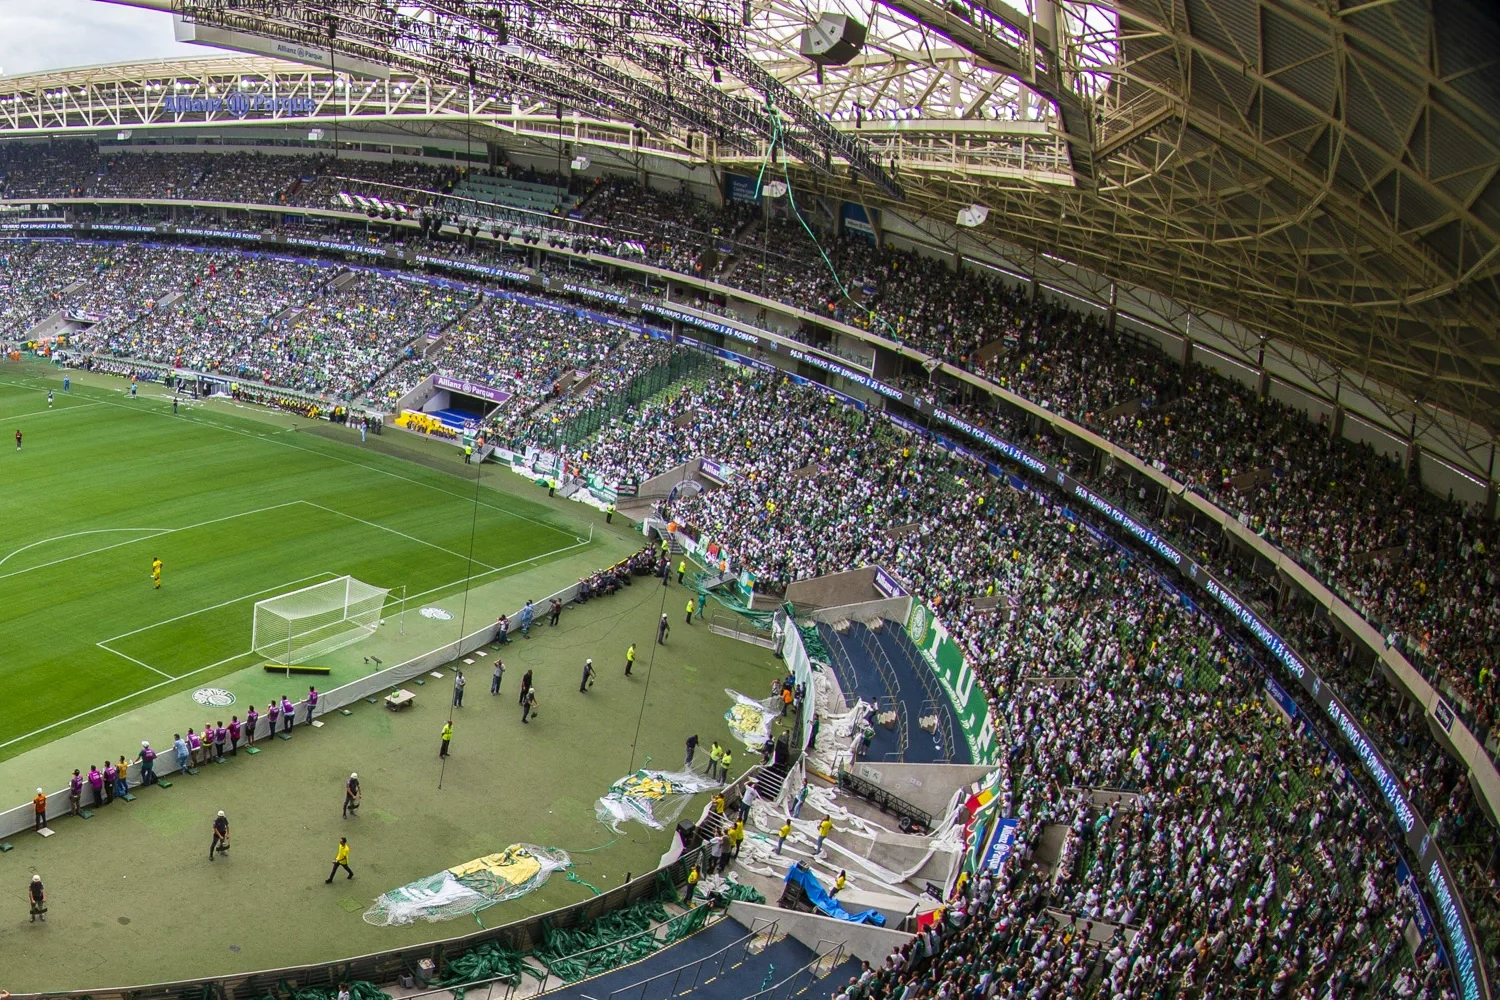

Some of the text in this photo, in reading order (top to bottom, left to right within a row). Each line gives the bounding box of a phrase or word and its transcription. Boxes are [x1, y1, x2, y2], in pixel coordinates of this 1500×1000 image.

[277, 44, 323, 60] Allianz Parque
[163, 93, 316, 116] Allianz Parque
[438, 378, 494, 398] Allianz Parque
